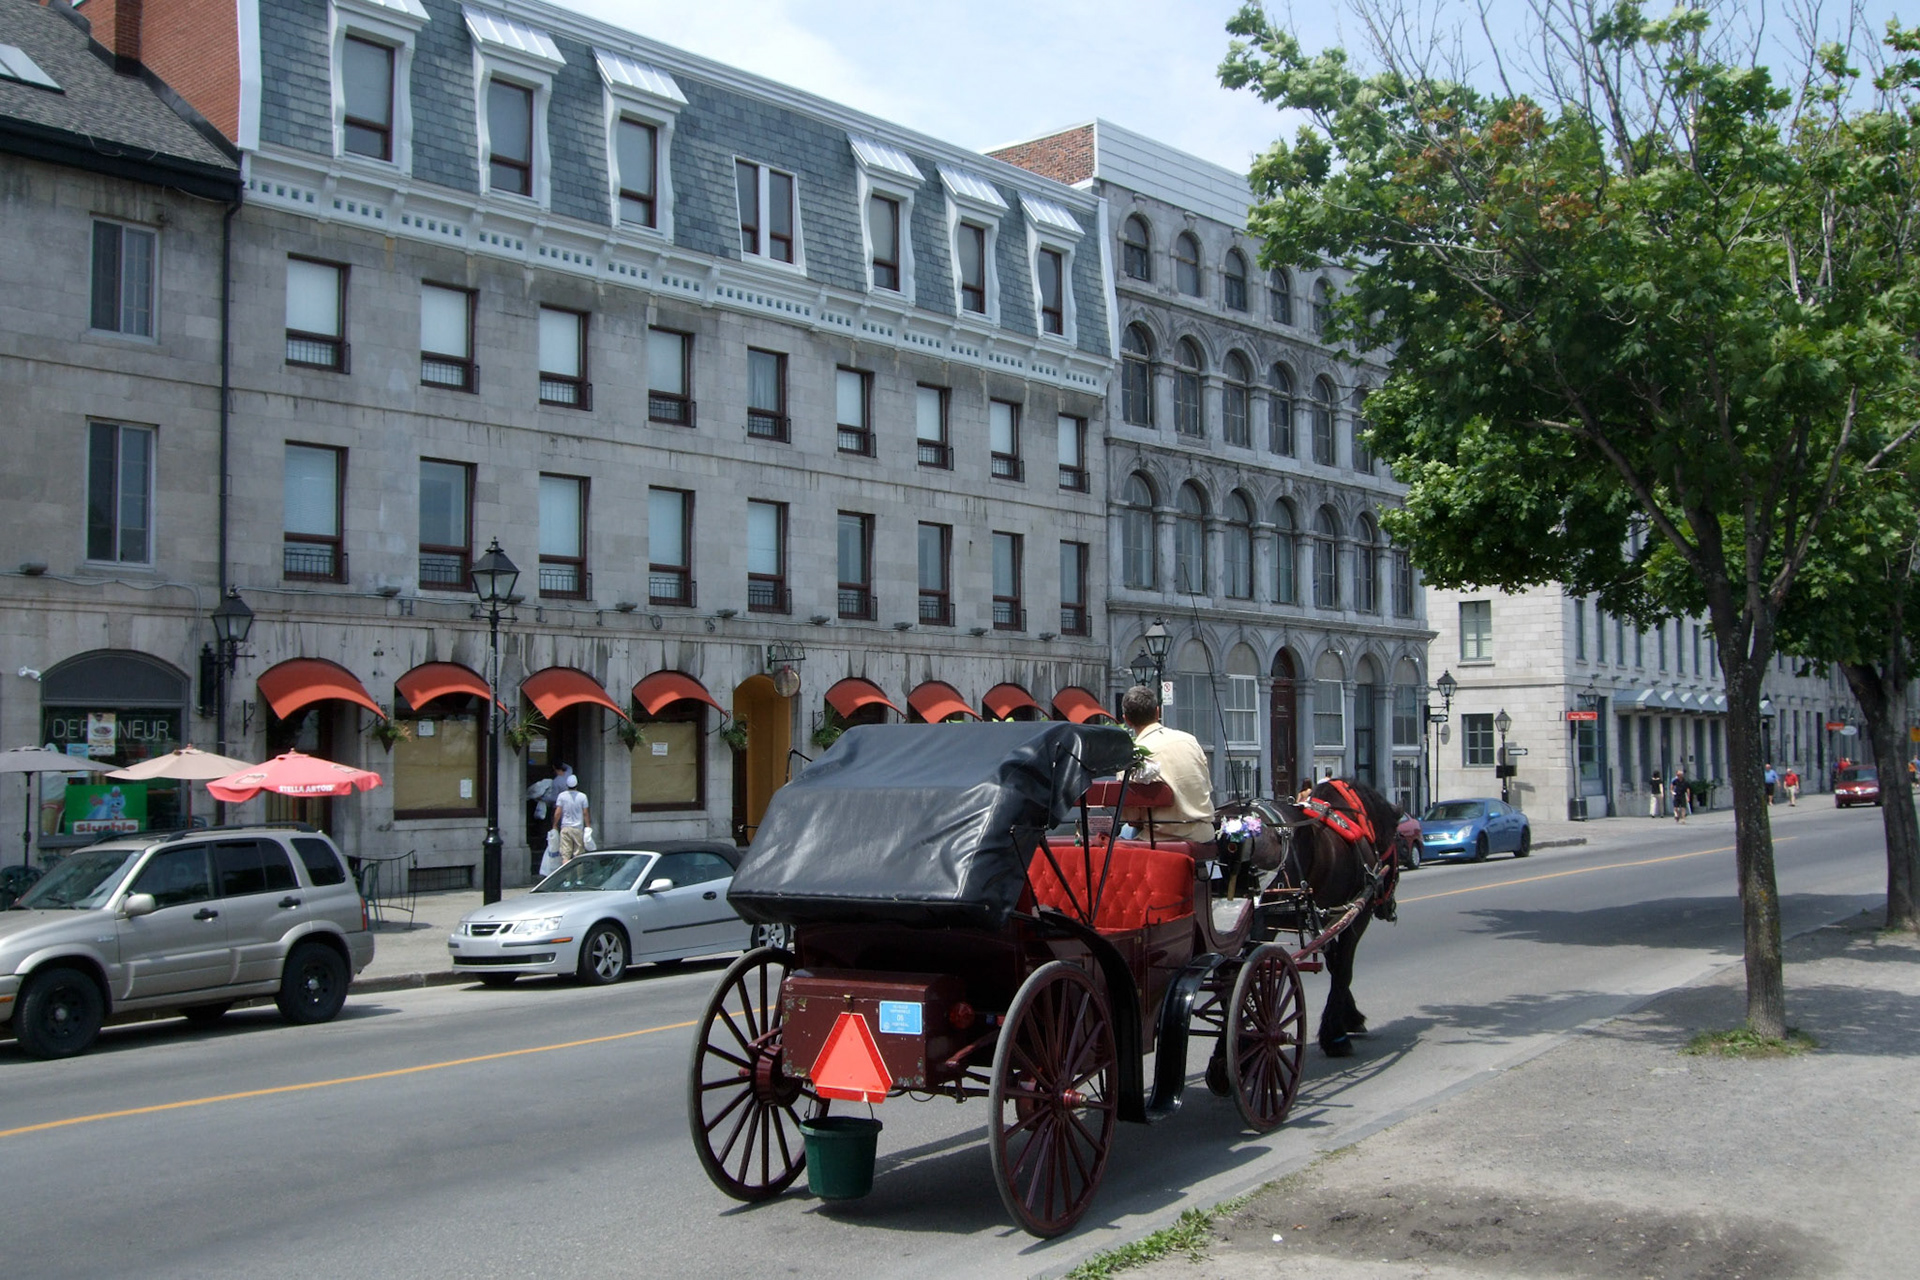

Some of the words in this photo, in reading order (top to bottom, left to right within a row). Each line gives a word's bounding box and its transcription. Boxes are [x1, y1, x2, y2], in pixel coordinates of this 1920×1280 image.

[52, 718, 169, 741] DEPNEUR
[279, 785, 303, 793] STELLA
[304, 784, 333, 792] ARTOIS
